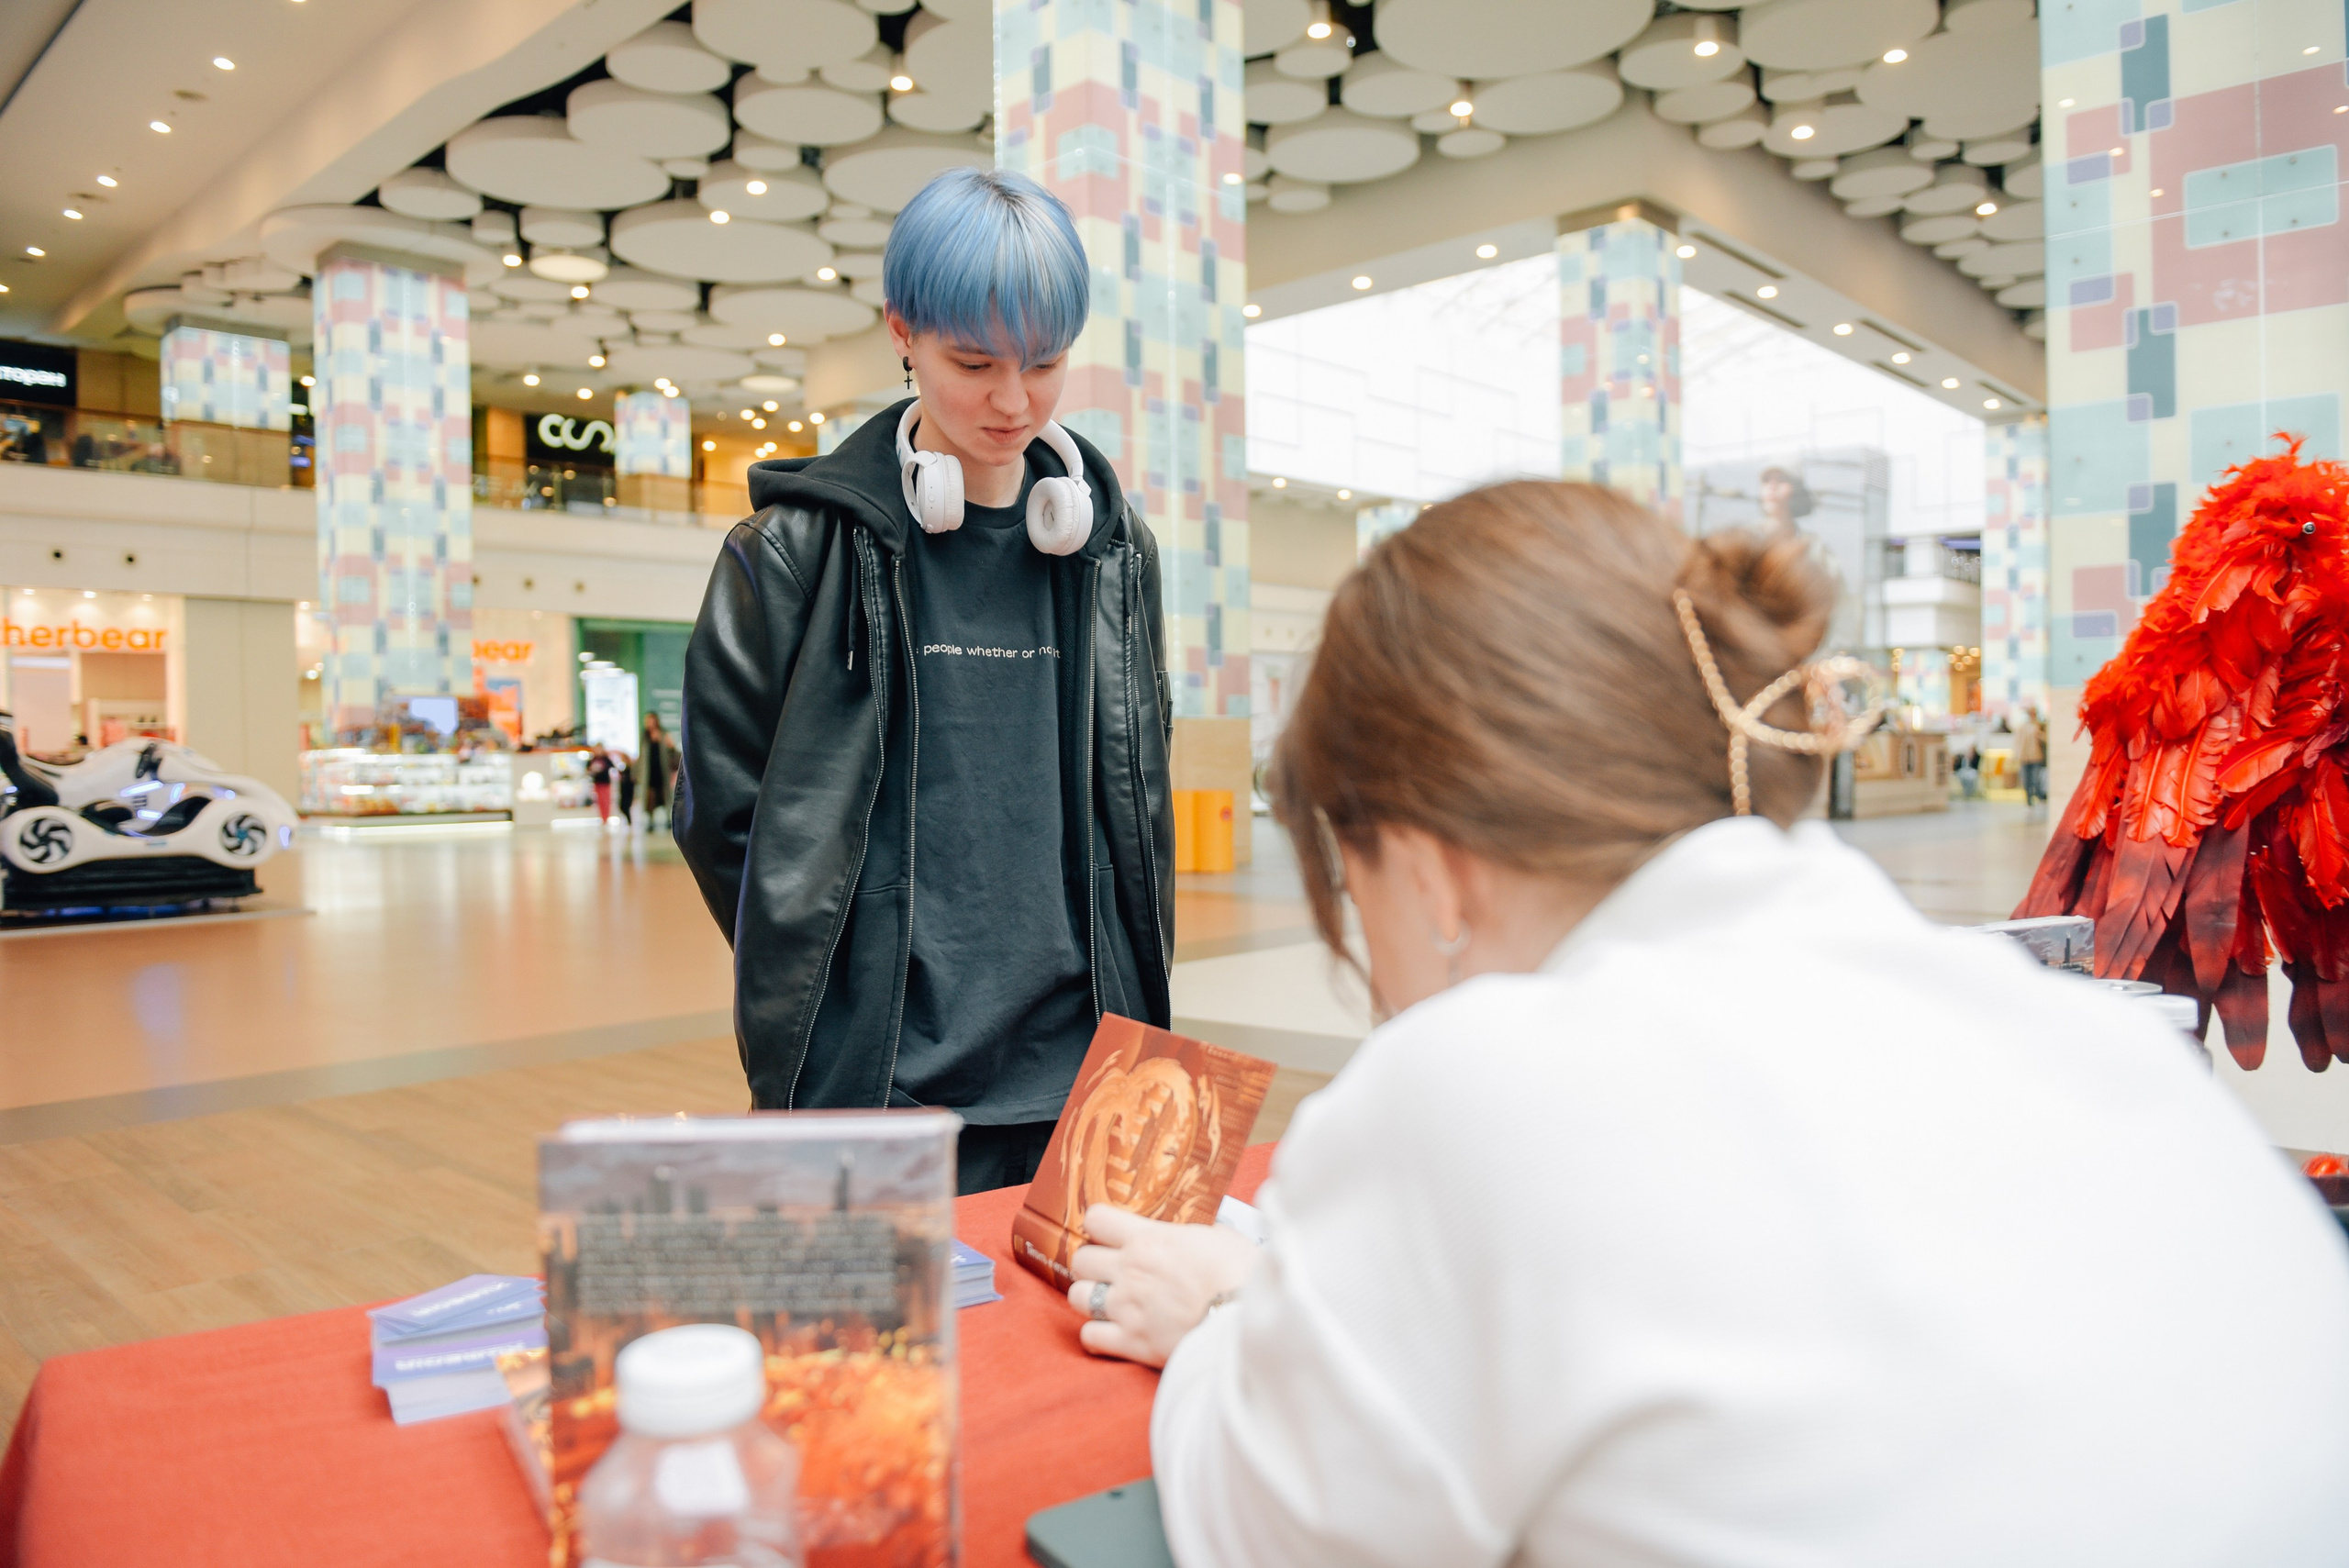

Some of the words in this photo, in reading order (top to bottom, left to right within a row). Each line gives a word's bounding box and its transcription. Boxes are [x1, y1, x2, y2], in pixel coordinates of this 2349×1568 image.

[0, 365, 67, 387] торан
[0, 617, 168, 651] herbear
[923, 643, 963, 656] people
[966, 645, 1019, 659] whether
[1021, 649, 1036, 659] or
